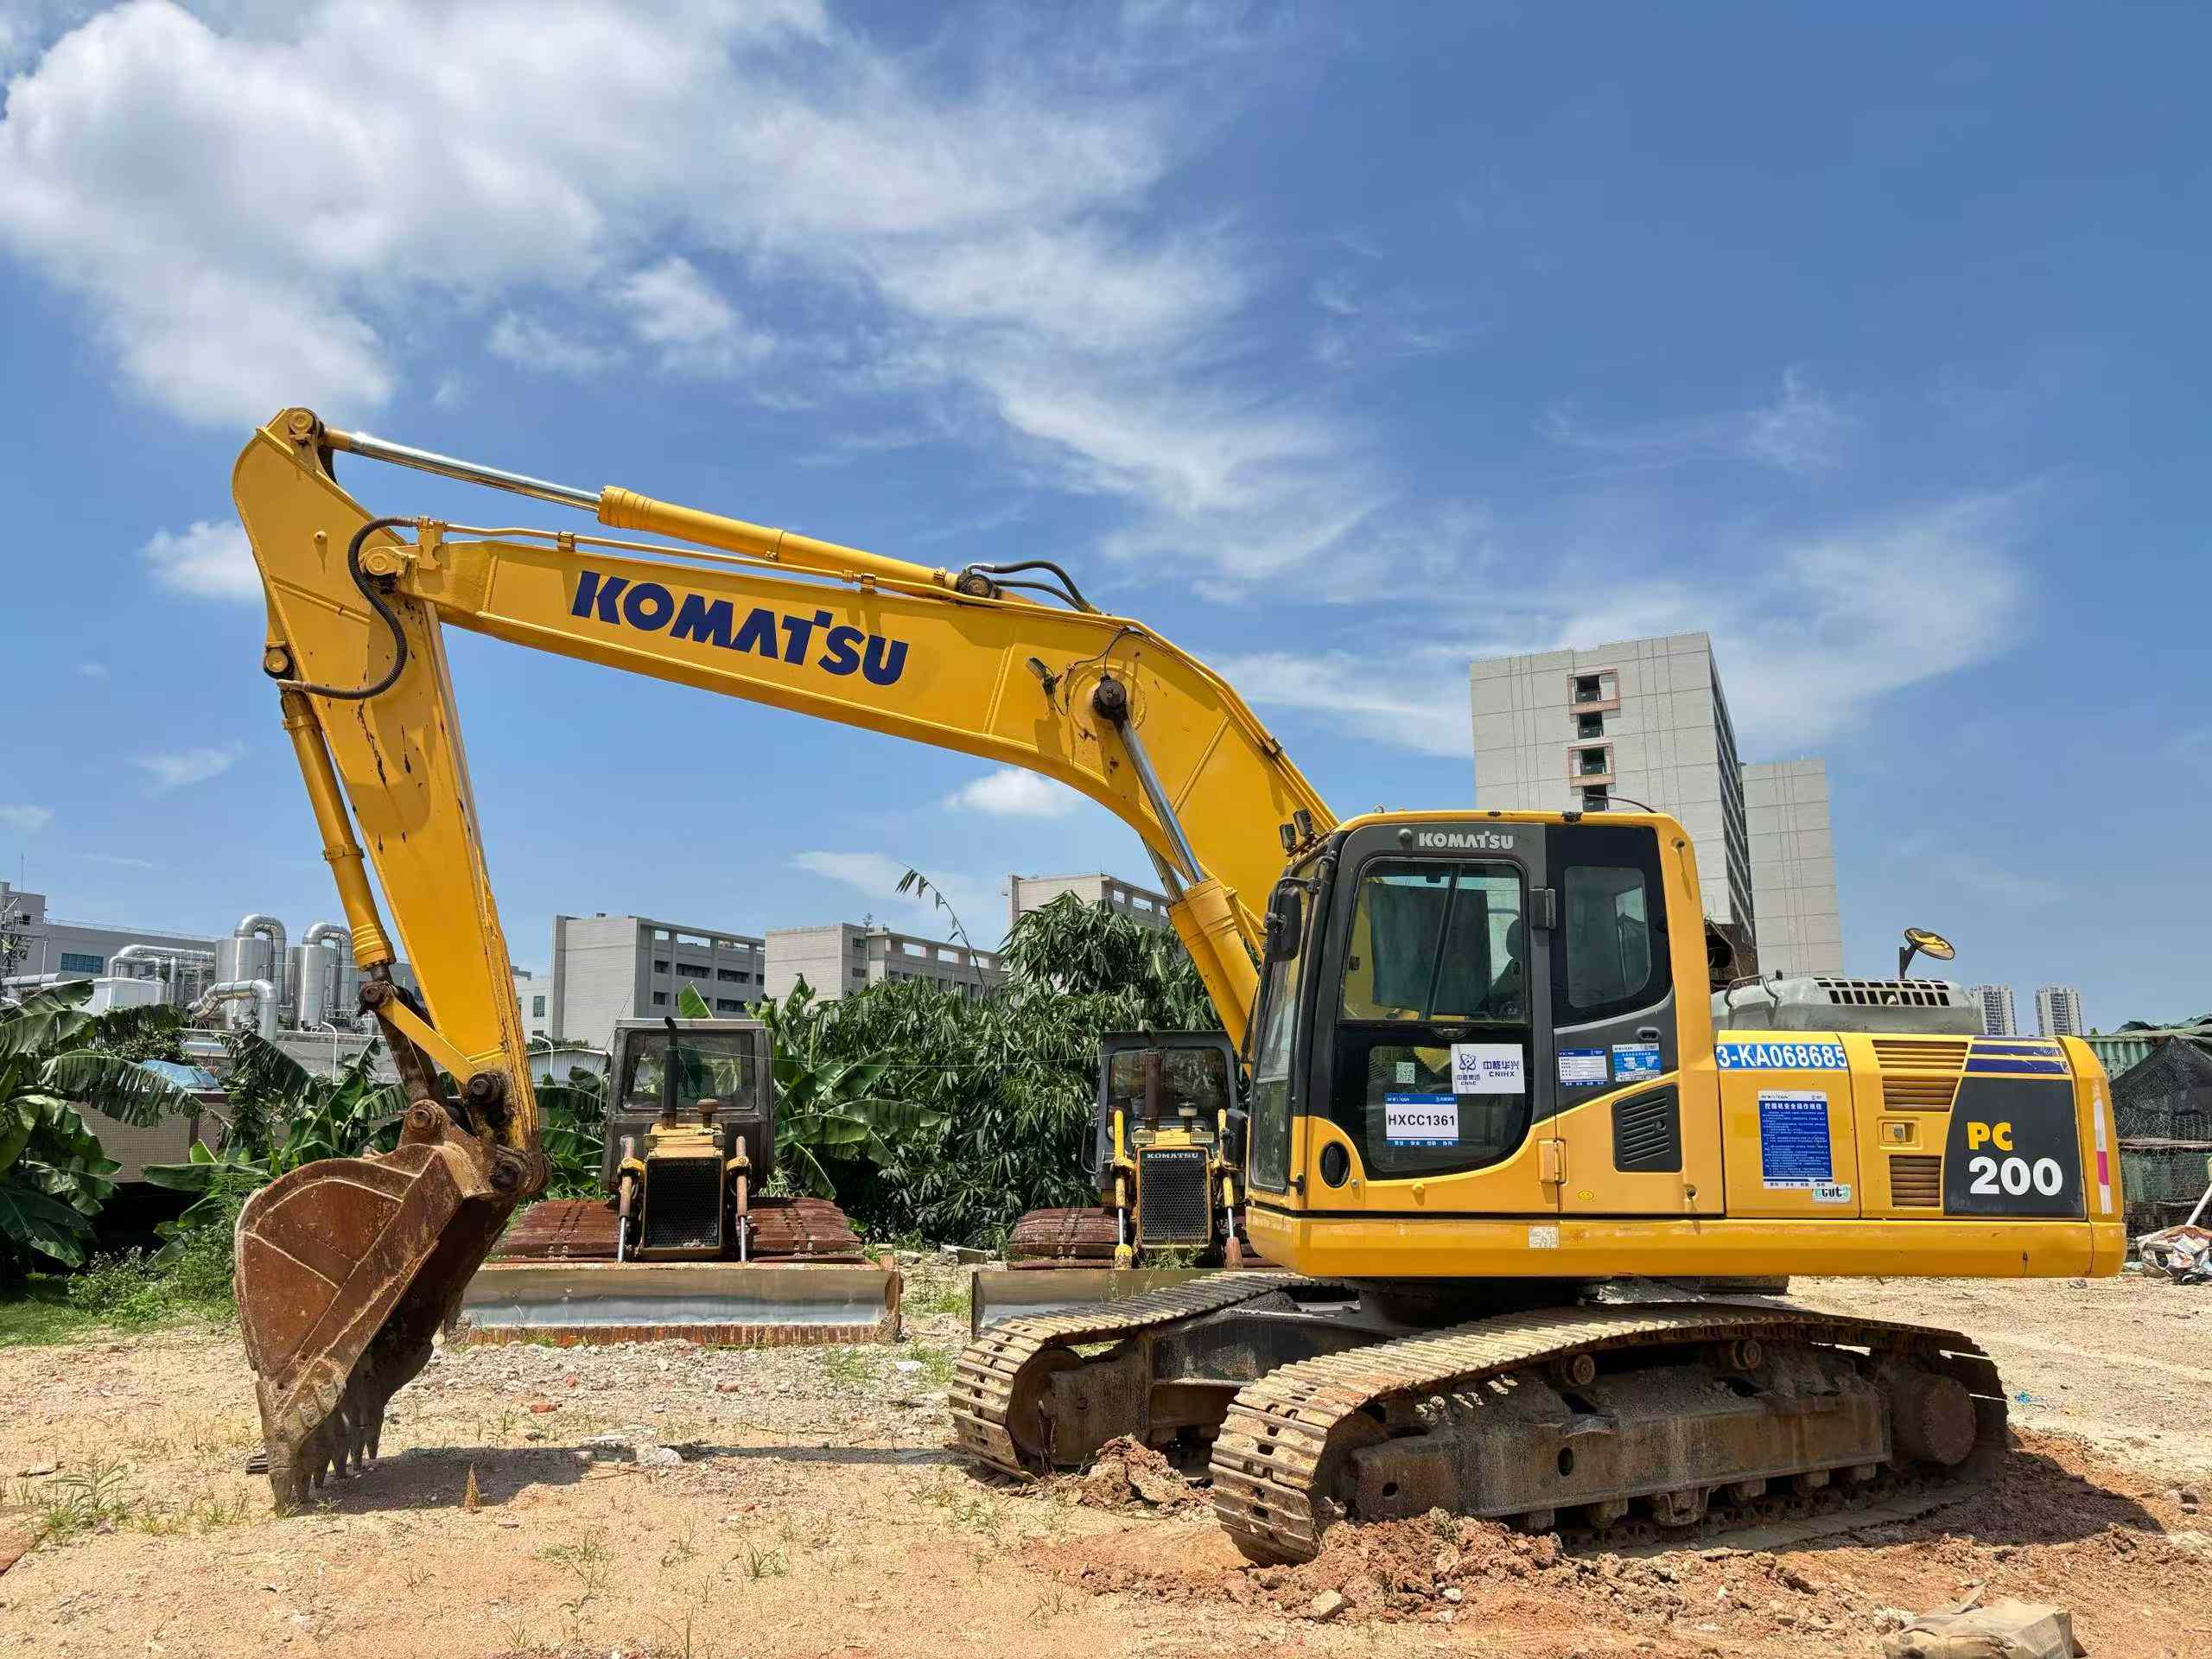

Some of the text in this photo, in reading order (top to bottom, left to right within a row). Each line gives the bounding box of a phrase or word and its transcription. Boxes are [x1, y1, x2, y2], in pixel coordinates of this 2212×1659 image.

[571, 570, 909, 686] KOMATSU
[1418, 830, 1514, 849] KOMATSU
[1388, 1114, 1455, 1127] HXCC1361
[1967, 1122, 2013, 1151] PC
[1968, 1156, 2063, 1196] 200
